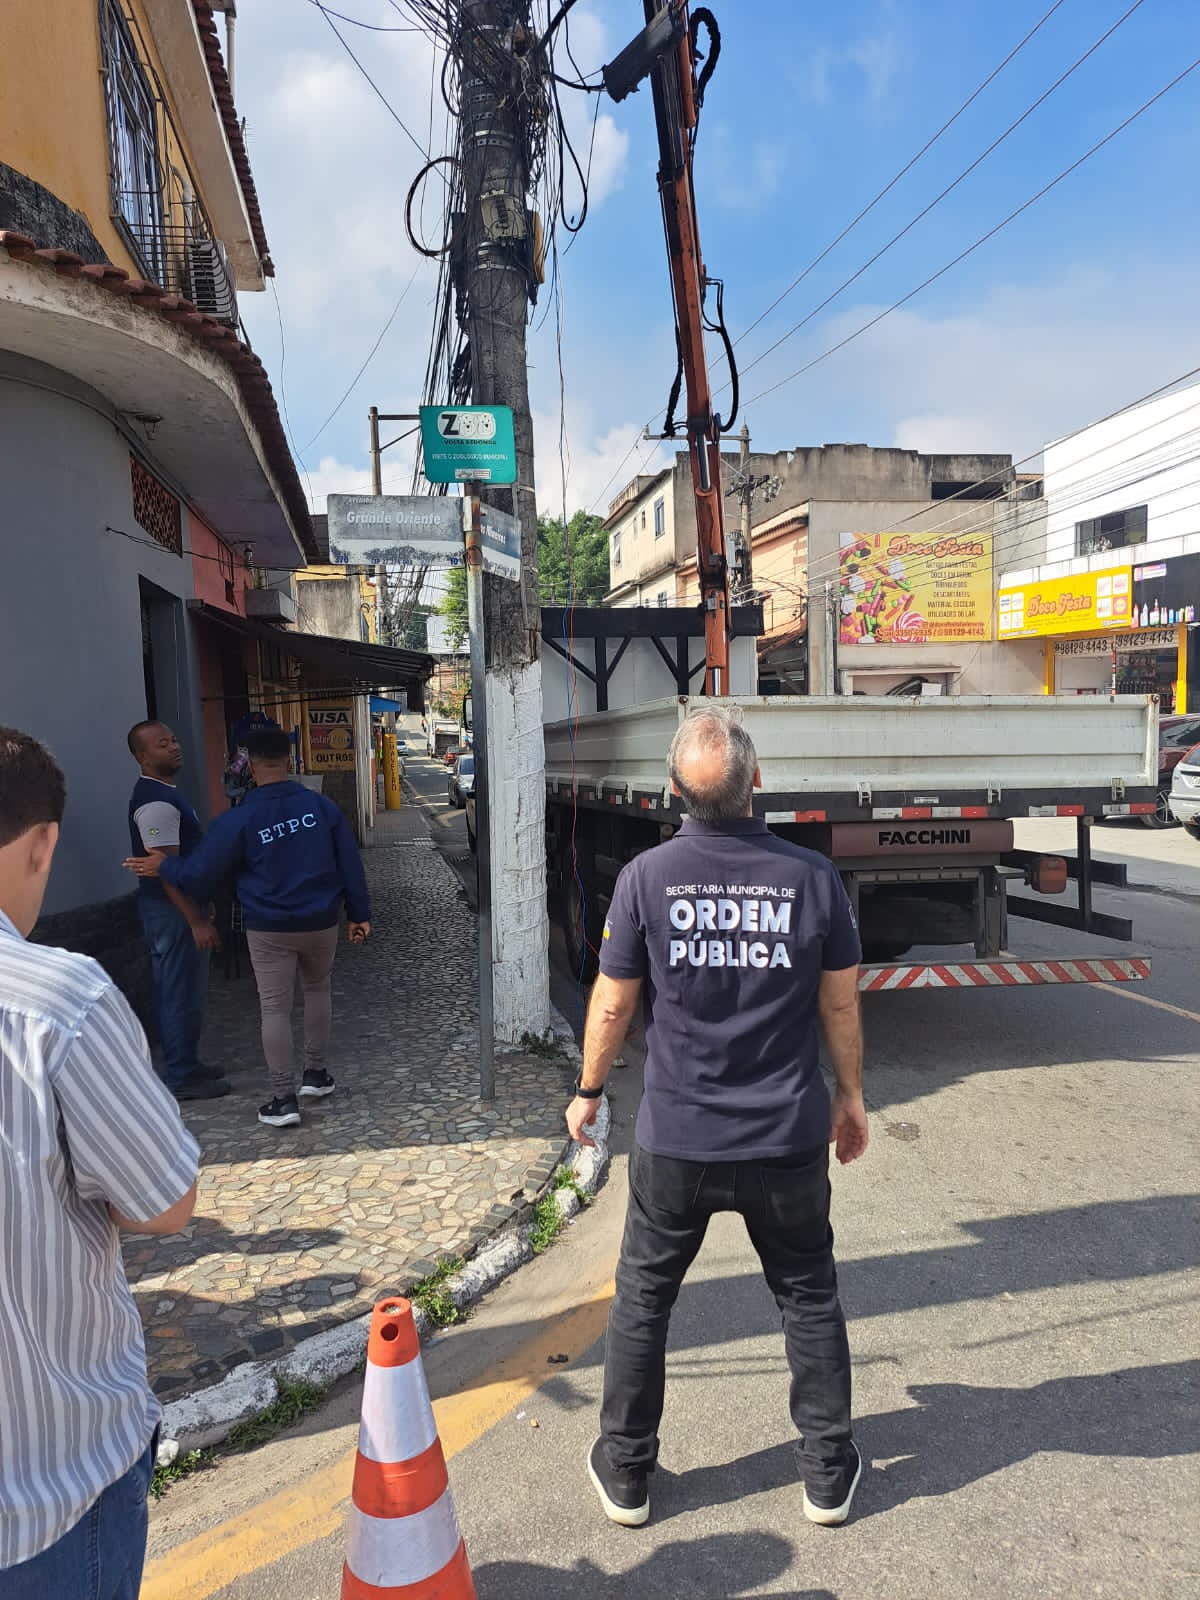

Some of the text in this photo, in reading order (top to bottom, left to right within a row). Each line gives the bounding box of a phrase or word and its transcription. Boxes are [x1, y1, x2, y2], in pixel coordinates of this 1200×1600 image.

[346, 511, 441, 526] Grande Oriente
[887, 535, 984, 558] Doce Festa
[1027, 592, 1092, 617] Doce Festa
[309, 712, 349, 724] VISA
[258, 814, 317, 844] ETPC
[878, 829, 970, 846] FACCHINI
[666, 885, 796, 898] SECRETARIA MUNICIPAL DE
[669, 899, 792, 934] ORDEM
[669, 933, 793, 969] PÚBLICA
